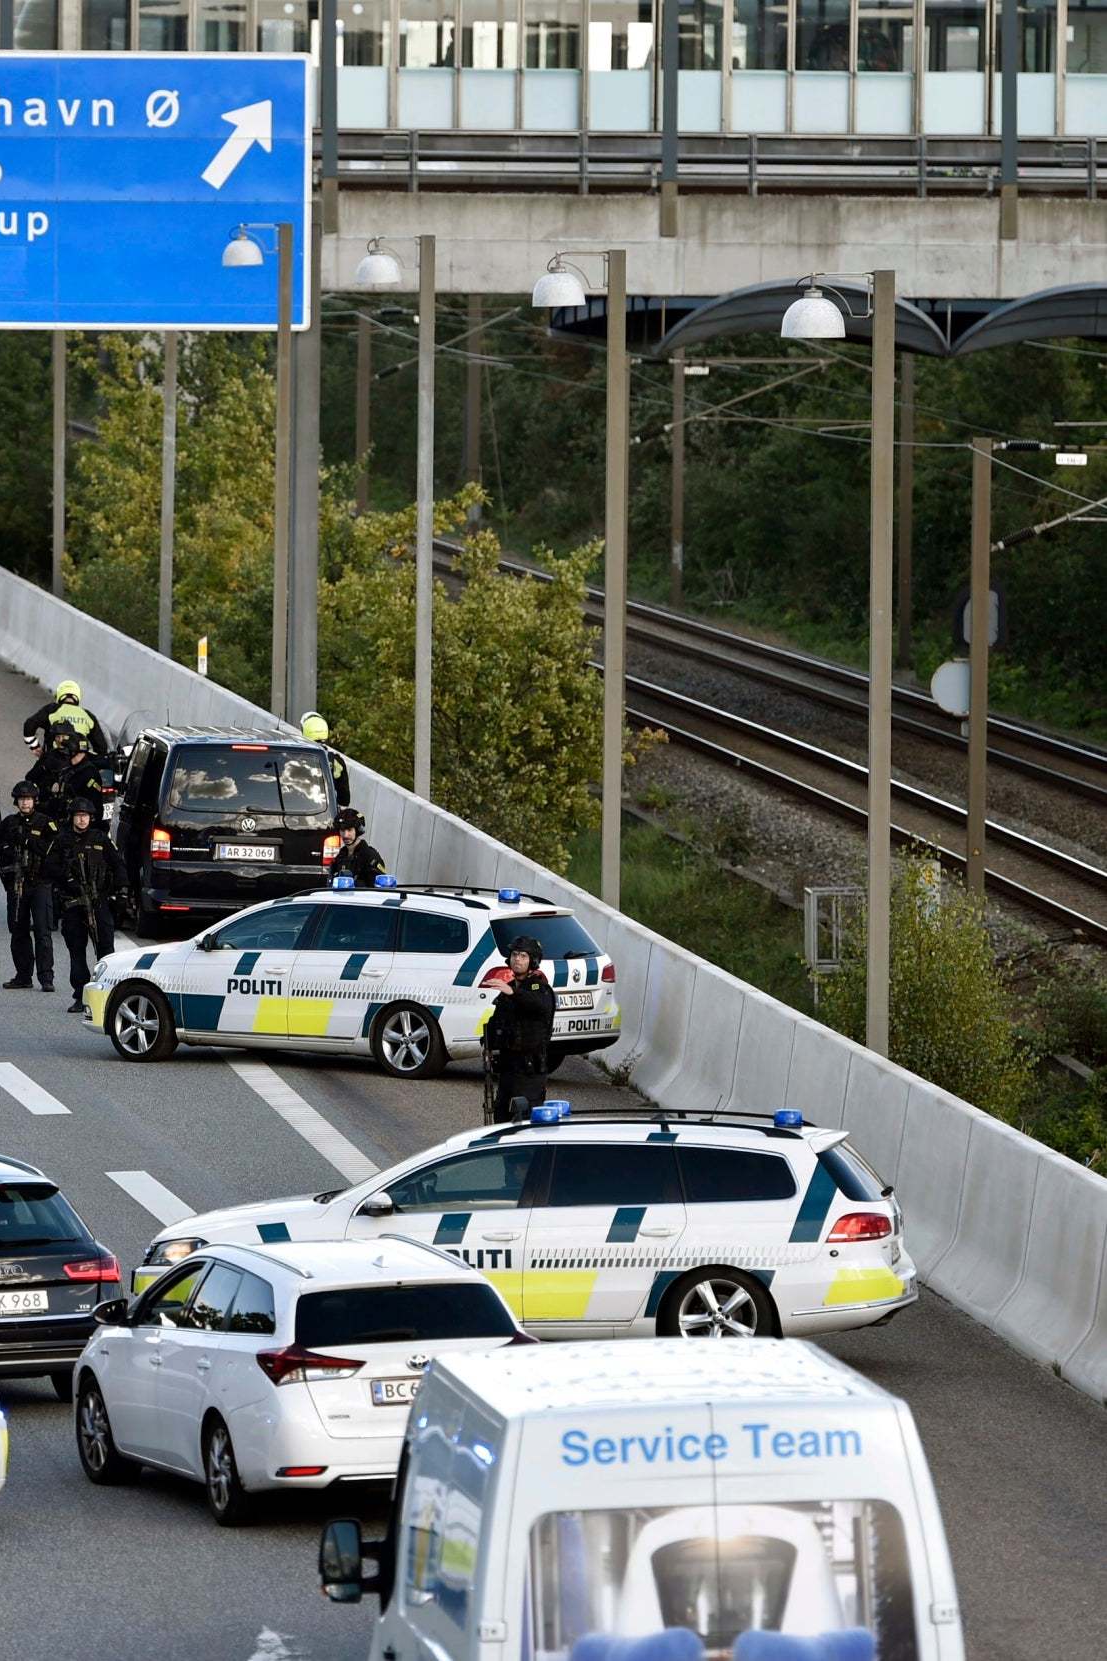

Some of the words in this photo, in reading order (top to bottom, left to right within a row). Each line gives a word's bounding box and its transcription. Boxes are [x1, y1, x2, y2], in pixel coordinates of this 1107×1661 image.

[145, 89, 180, 128] Ø
[226, 845, 240, 857] AR
[241, 845, 253, 857] 32
[256, 847, 273, 858] 069
[226, 978, 283, 996] POLITI
[568, 1018, 601, 1032] POLITI
[11, 1293, 42, 1308] 968
[384, 1383, 407, 1399] BC
[562, 1426, 728, 1467] Service
[741, 1423, 862, 1459] Team
